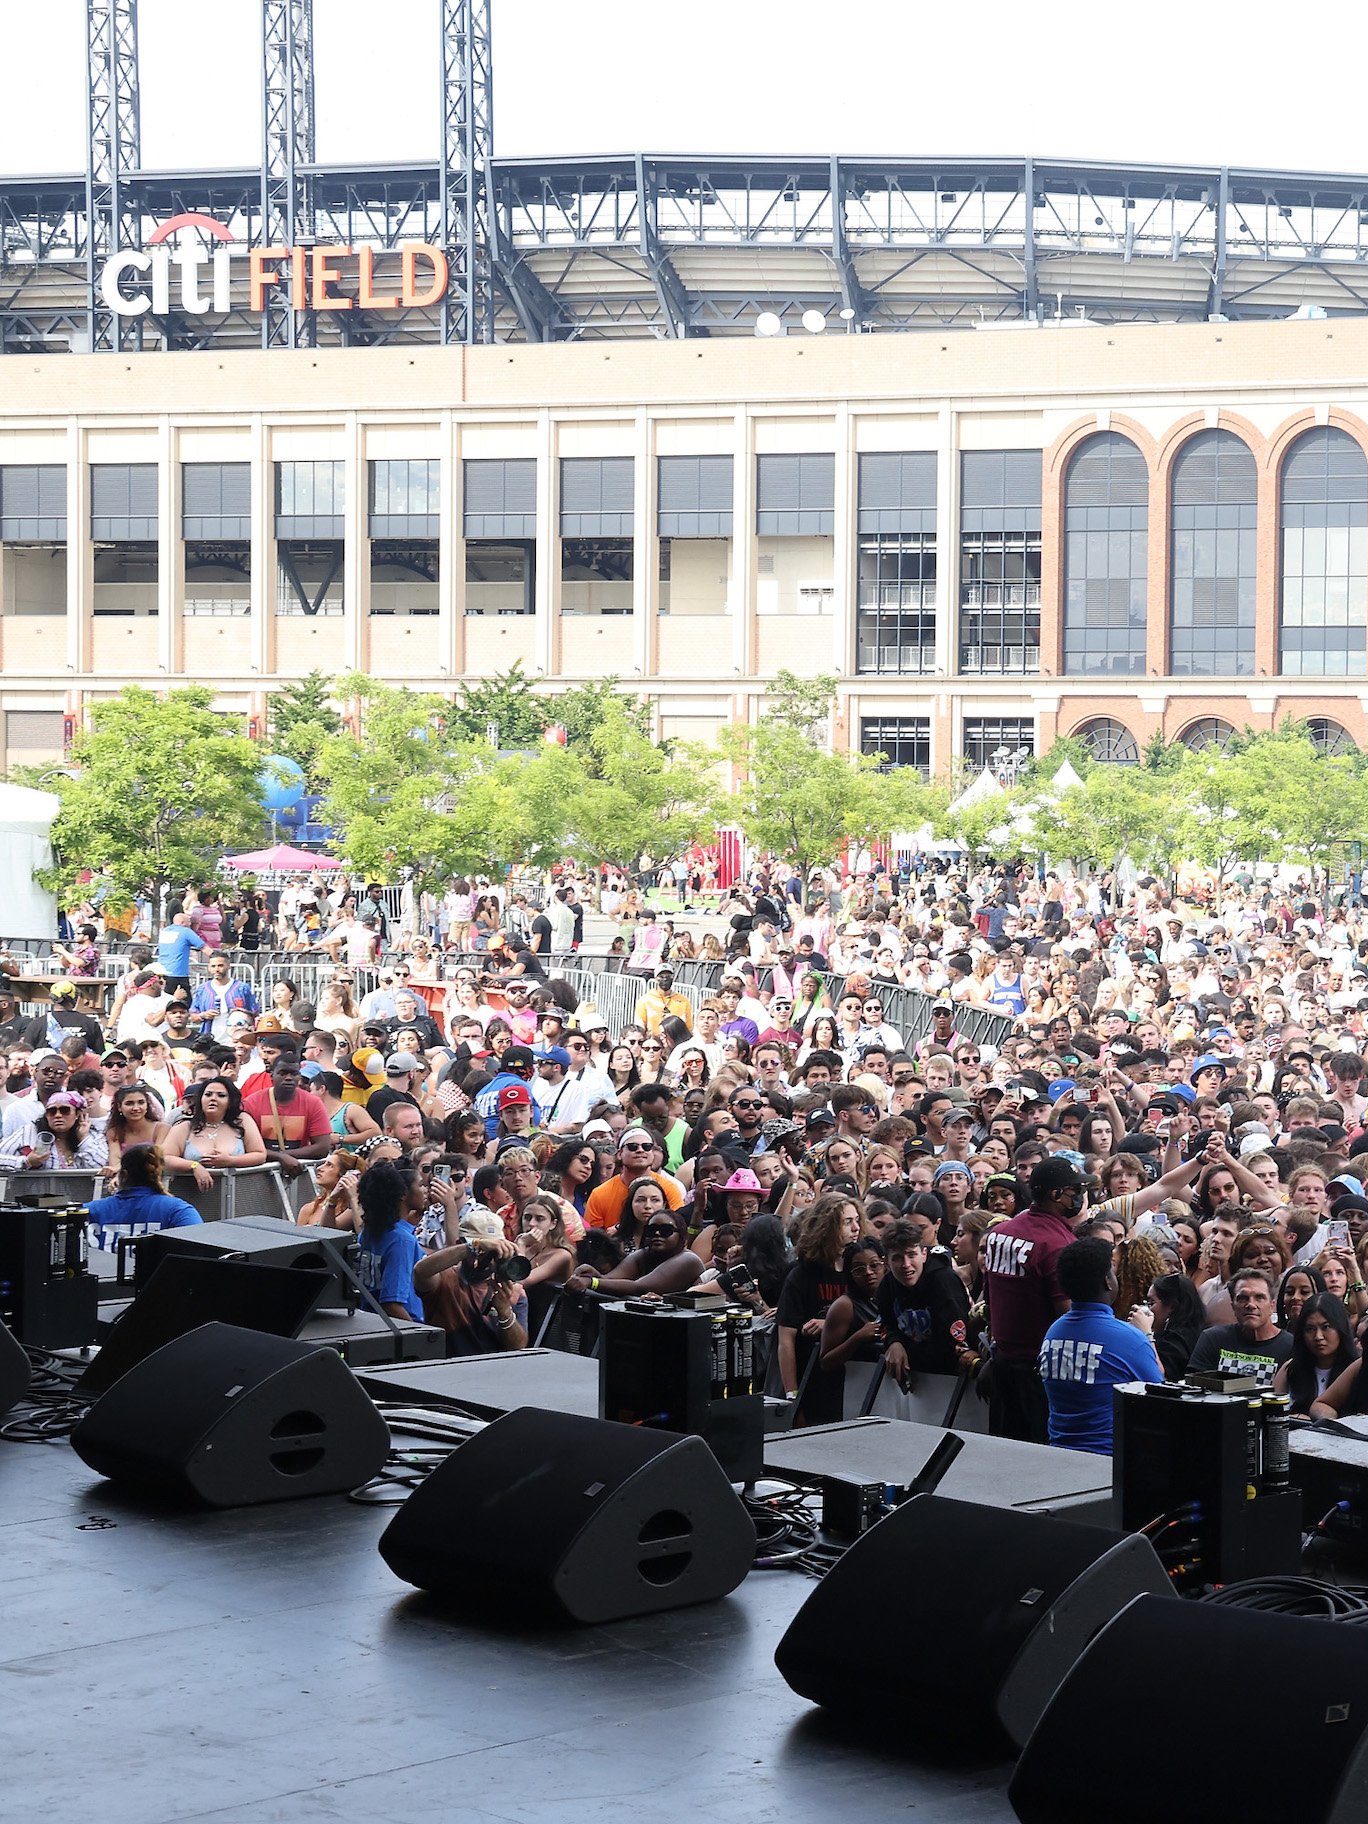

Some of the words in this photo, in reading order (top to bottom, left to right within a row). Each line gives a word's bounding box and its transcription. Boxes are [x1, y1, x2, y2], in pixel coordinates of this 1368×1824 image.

[101, 216, 233, 316] citi
[249, 243, 448, 312] FIELD
[985, 1232, 1035, 1276] STAFF
[1039, 1339, 1104, 1384] STAFF
